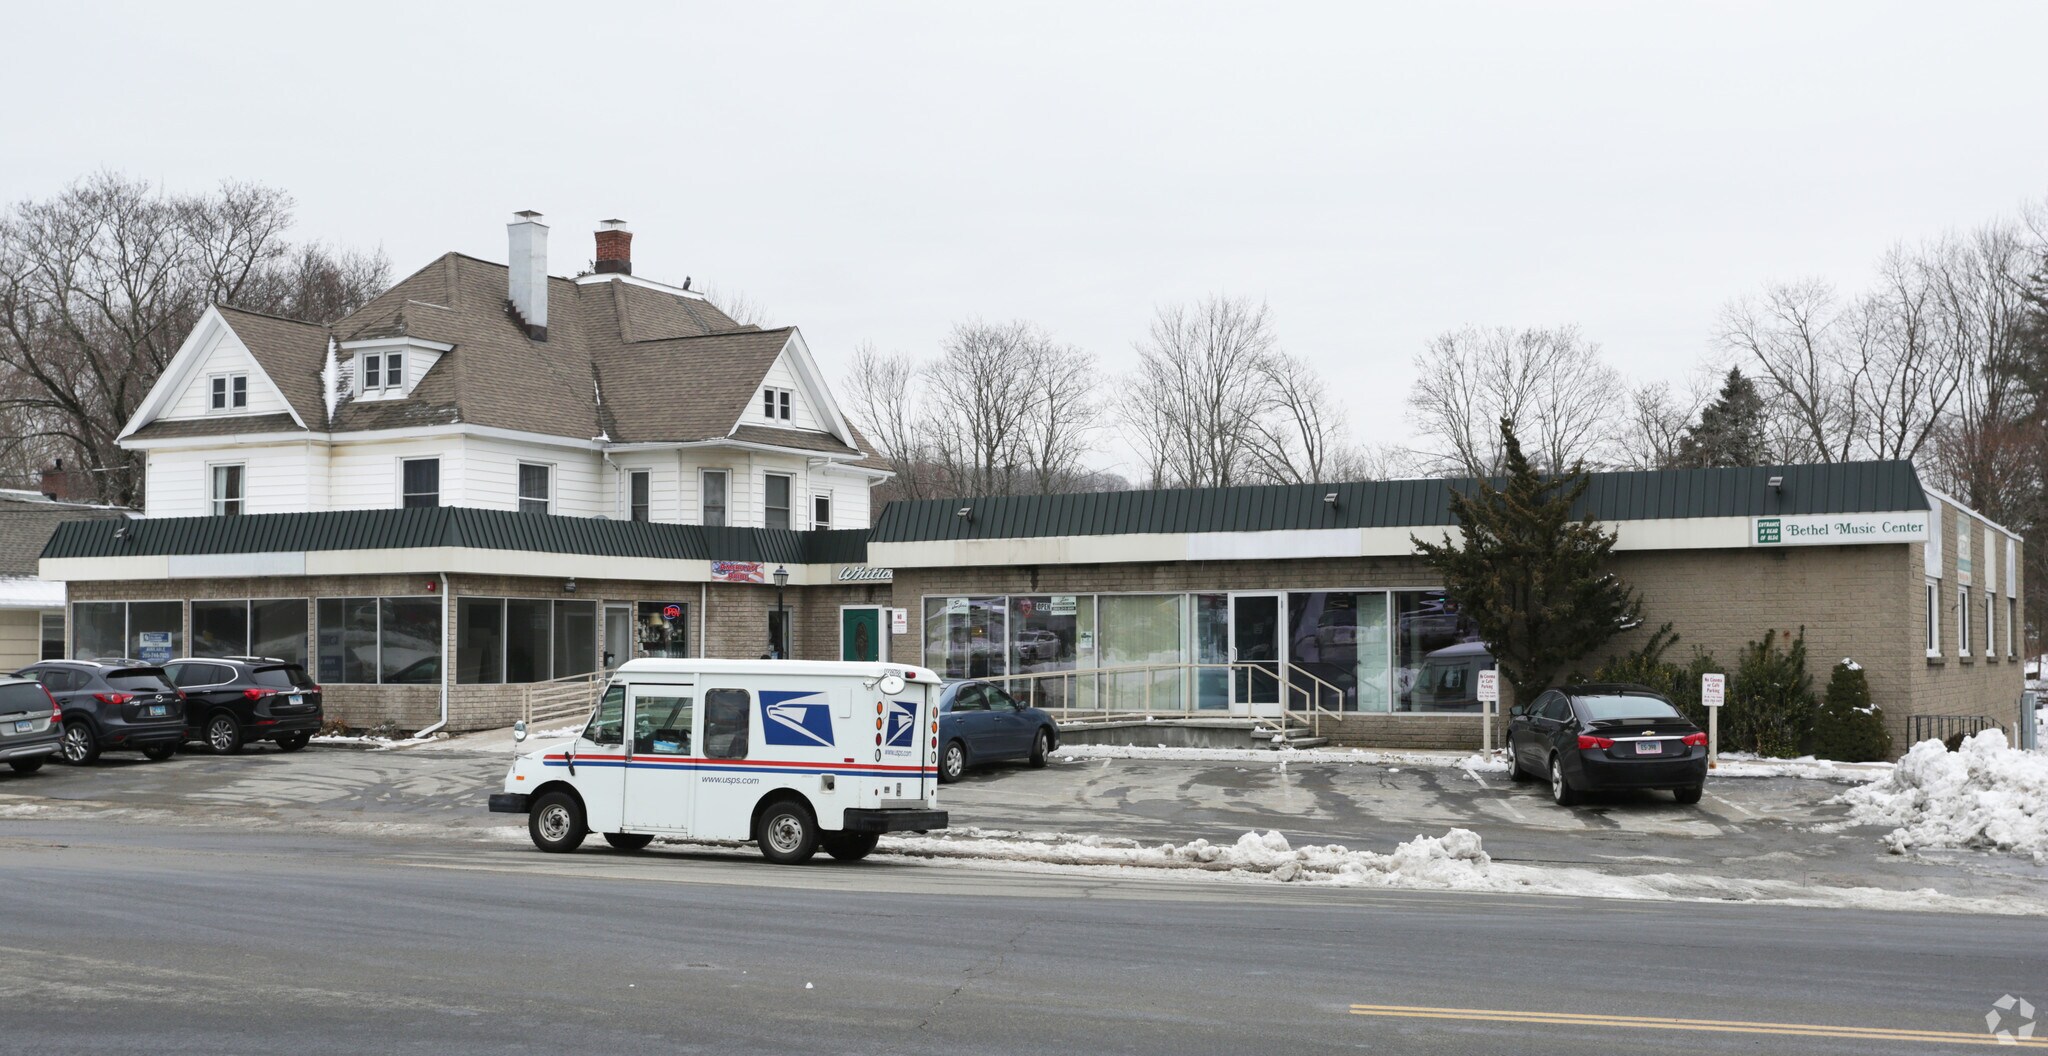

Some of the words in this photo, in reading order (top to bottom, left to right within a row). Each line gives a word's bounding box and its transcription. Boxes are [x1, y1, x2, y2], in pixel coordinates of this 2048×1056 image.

[1785, 523, 1829, 537] Bethel
[1834, 522, 1876, 535] Music
[1882, 521, 1924, 533] Center
[663, 606, 681, 617] OPEN
[701, 776, 760, 785] www.usps.com
